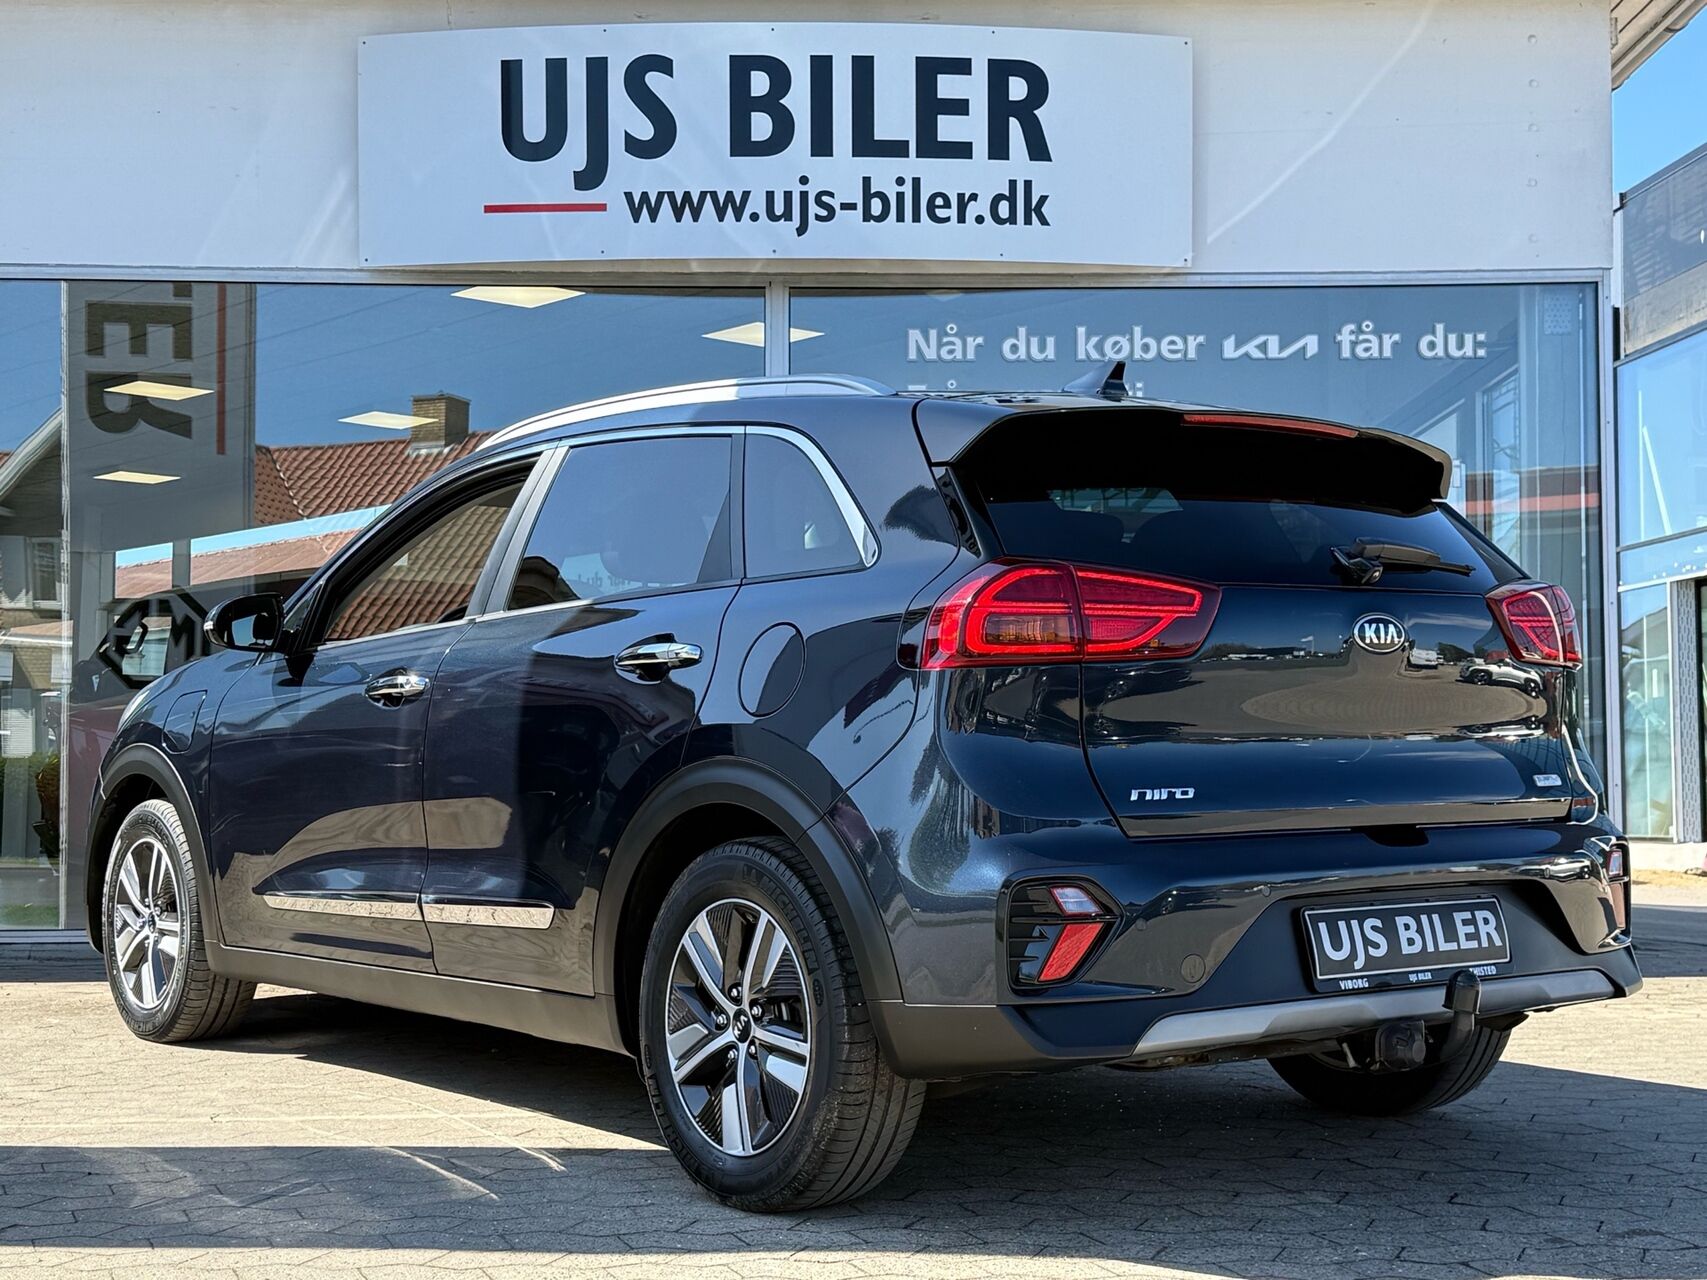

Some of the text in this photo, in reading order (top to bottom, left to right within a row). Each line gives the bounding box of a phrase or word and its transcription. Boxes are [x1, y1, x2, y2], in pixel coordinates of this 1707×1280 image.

[501, 54, 1053, 190] UJS BILER
[624, 175, 1051, 238] www.ujs-biler.dk
[907, 323, 984, 362] Når
[1001, 326, 1056, 362] du
[1075, 325, 1206, 362] køber
[1335, 320, 1400, 360] får
[1418, 323, 1487, 360] du:
[1363, 622, 1399, 645] KIA
[1317, 910, 1503, 970] UJS BILER
[1339, 977, 1370, 991] VIBORG
